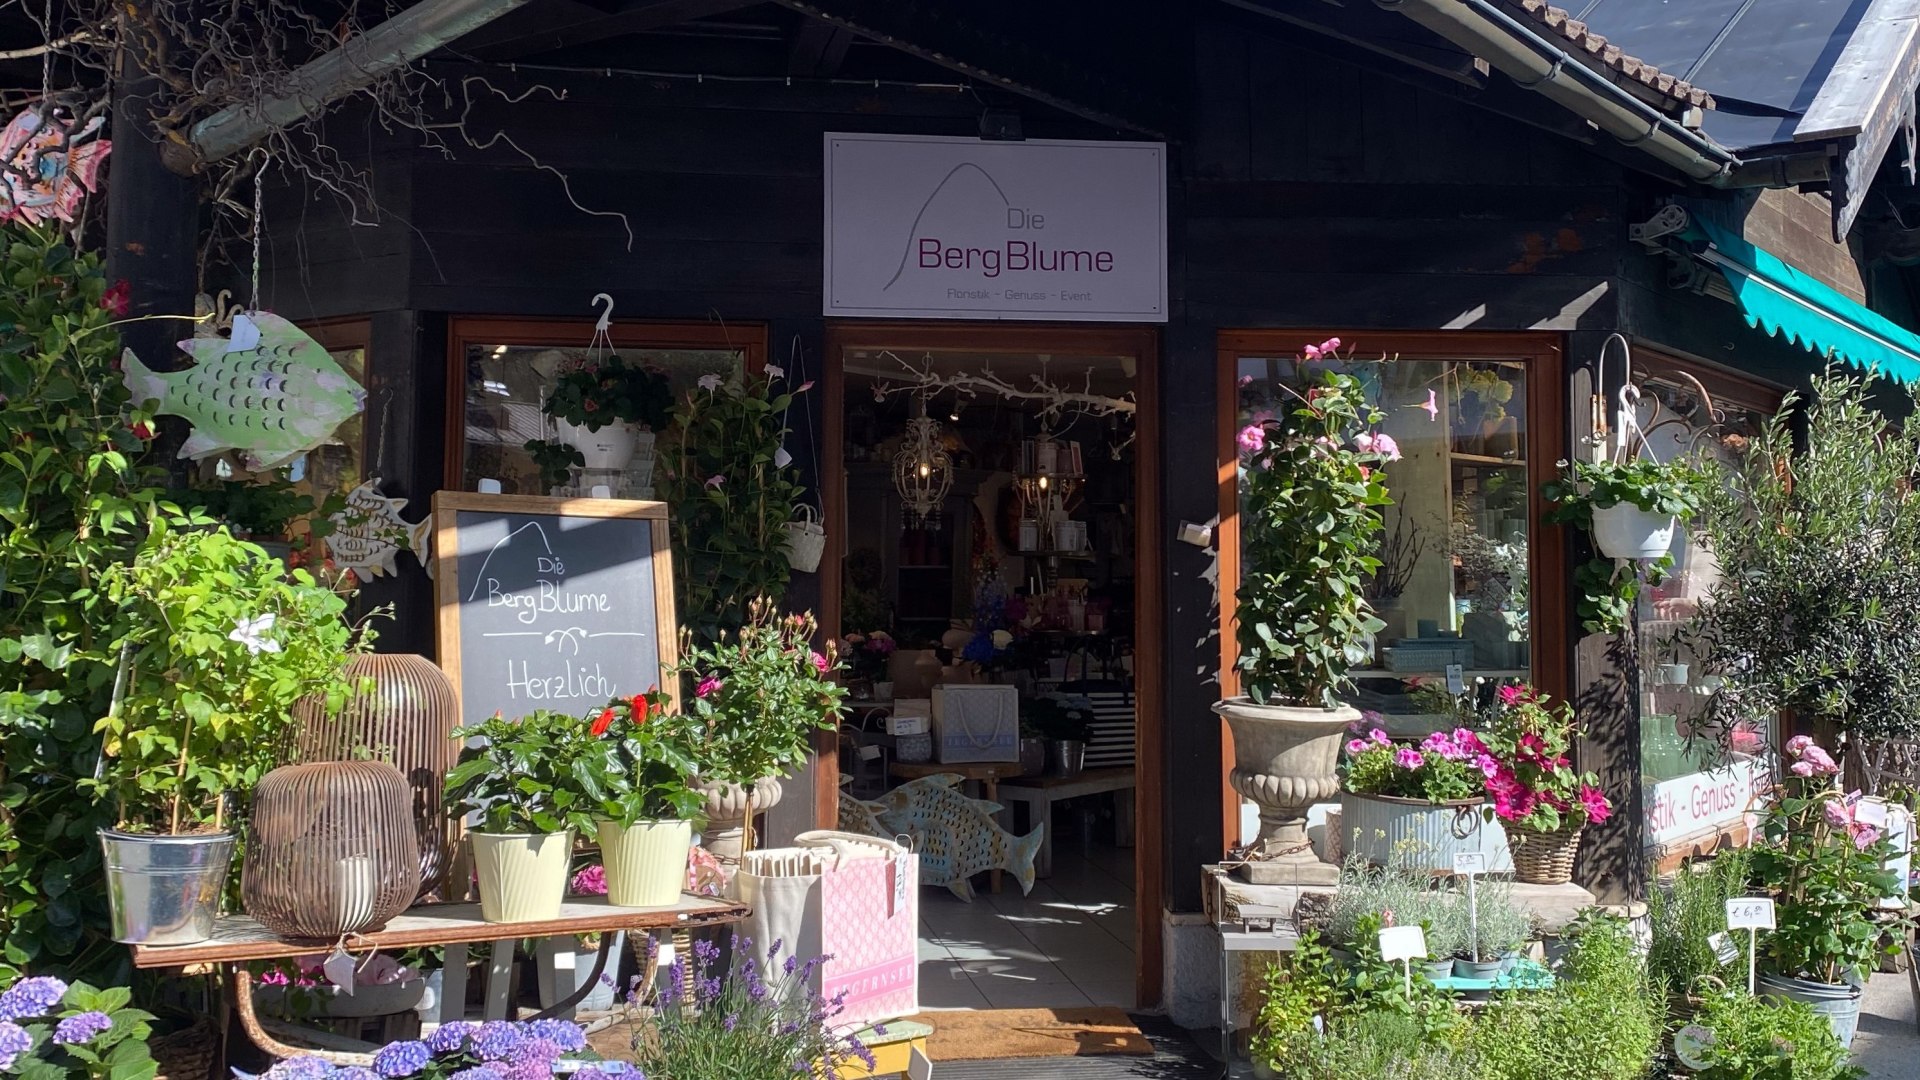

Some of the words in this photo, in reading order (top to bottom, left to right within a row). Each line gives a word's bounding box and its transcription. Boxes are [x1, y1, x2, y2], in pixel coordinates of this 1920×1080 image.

[1007, 207, 1045, 230] Die
[918, 237, 1114, 278] BergBlume
[946, 287, 990, 300] Floristik
[1004, 289, 1047, 301] Genuss
[1060, 290, 1093, 302] Event
[536, 556, 566, 576] Die
[506, 658, 617, 700] Herzlich
[1691, 781, 1736, 820] Genuss
